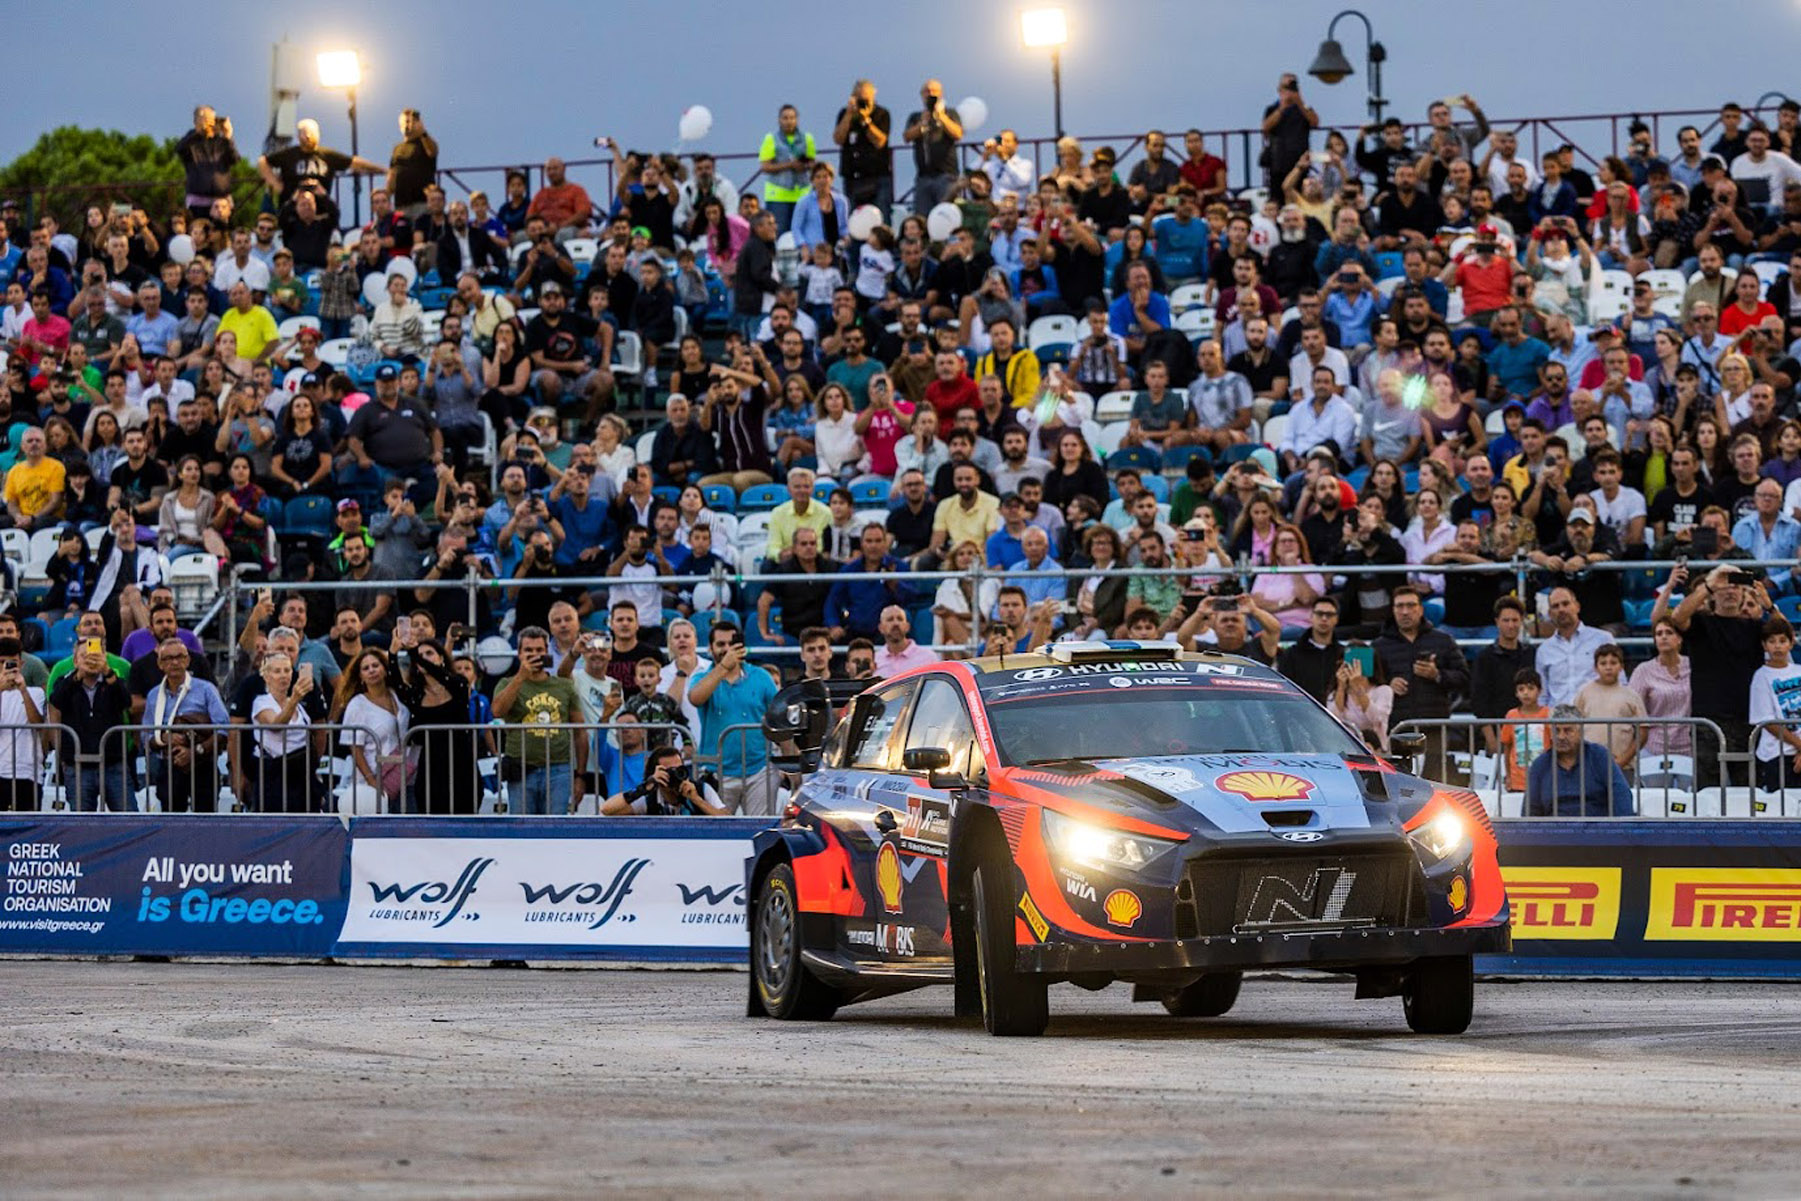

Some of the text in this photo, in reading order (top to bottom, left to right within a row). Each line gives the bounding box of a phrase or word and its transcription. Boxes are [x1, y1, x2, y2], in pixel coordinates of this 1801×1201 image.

[1068, 661, 1184, 675] HYUNDAI
[1135, 677, 1192, 685] WRC
[9, 843, 60, 859] GREEK
[7, 861, 83, 877] NATIONAL
[142, 857, 293, 889] All you want
[7, 879, 76, 895] TOURISM
[4, 896, 111, 913] ORGANISATION
[137, 886, 324, 924] is Greece.
[1671, 883, 1801, 929] PIRE
[369, 909, 440, 922] LUBRICANTS
[524, 911, 596, 924] LUBRICANTS
[681, 913, 747, 924] LUBRICANT
[0, 918, 105, 934] www.visitgreece.gr
